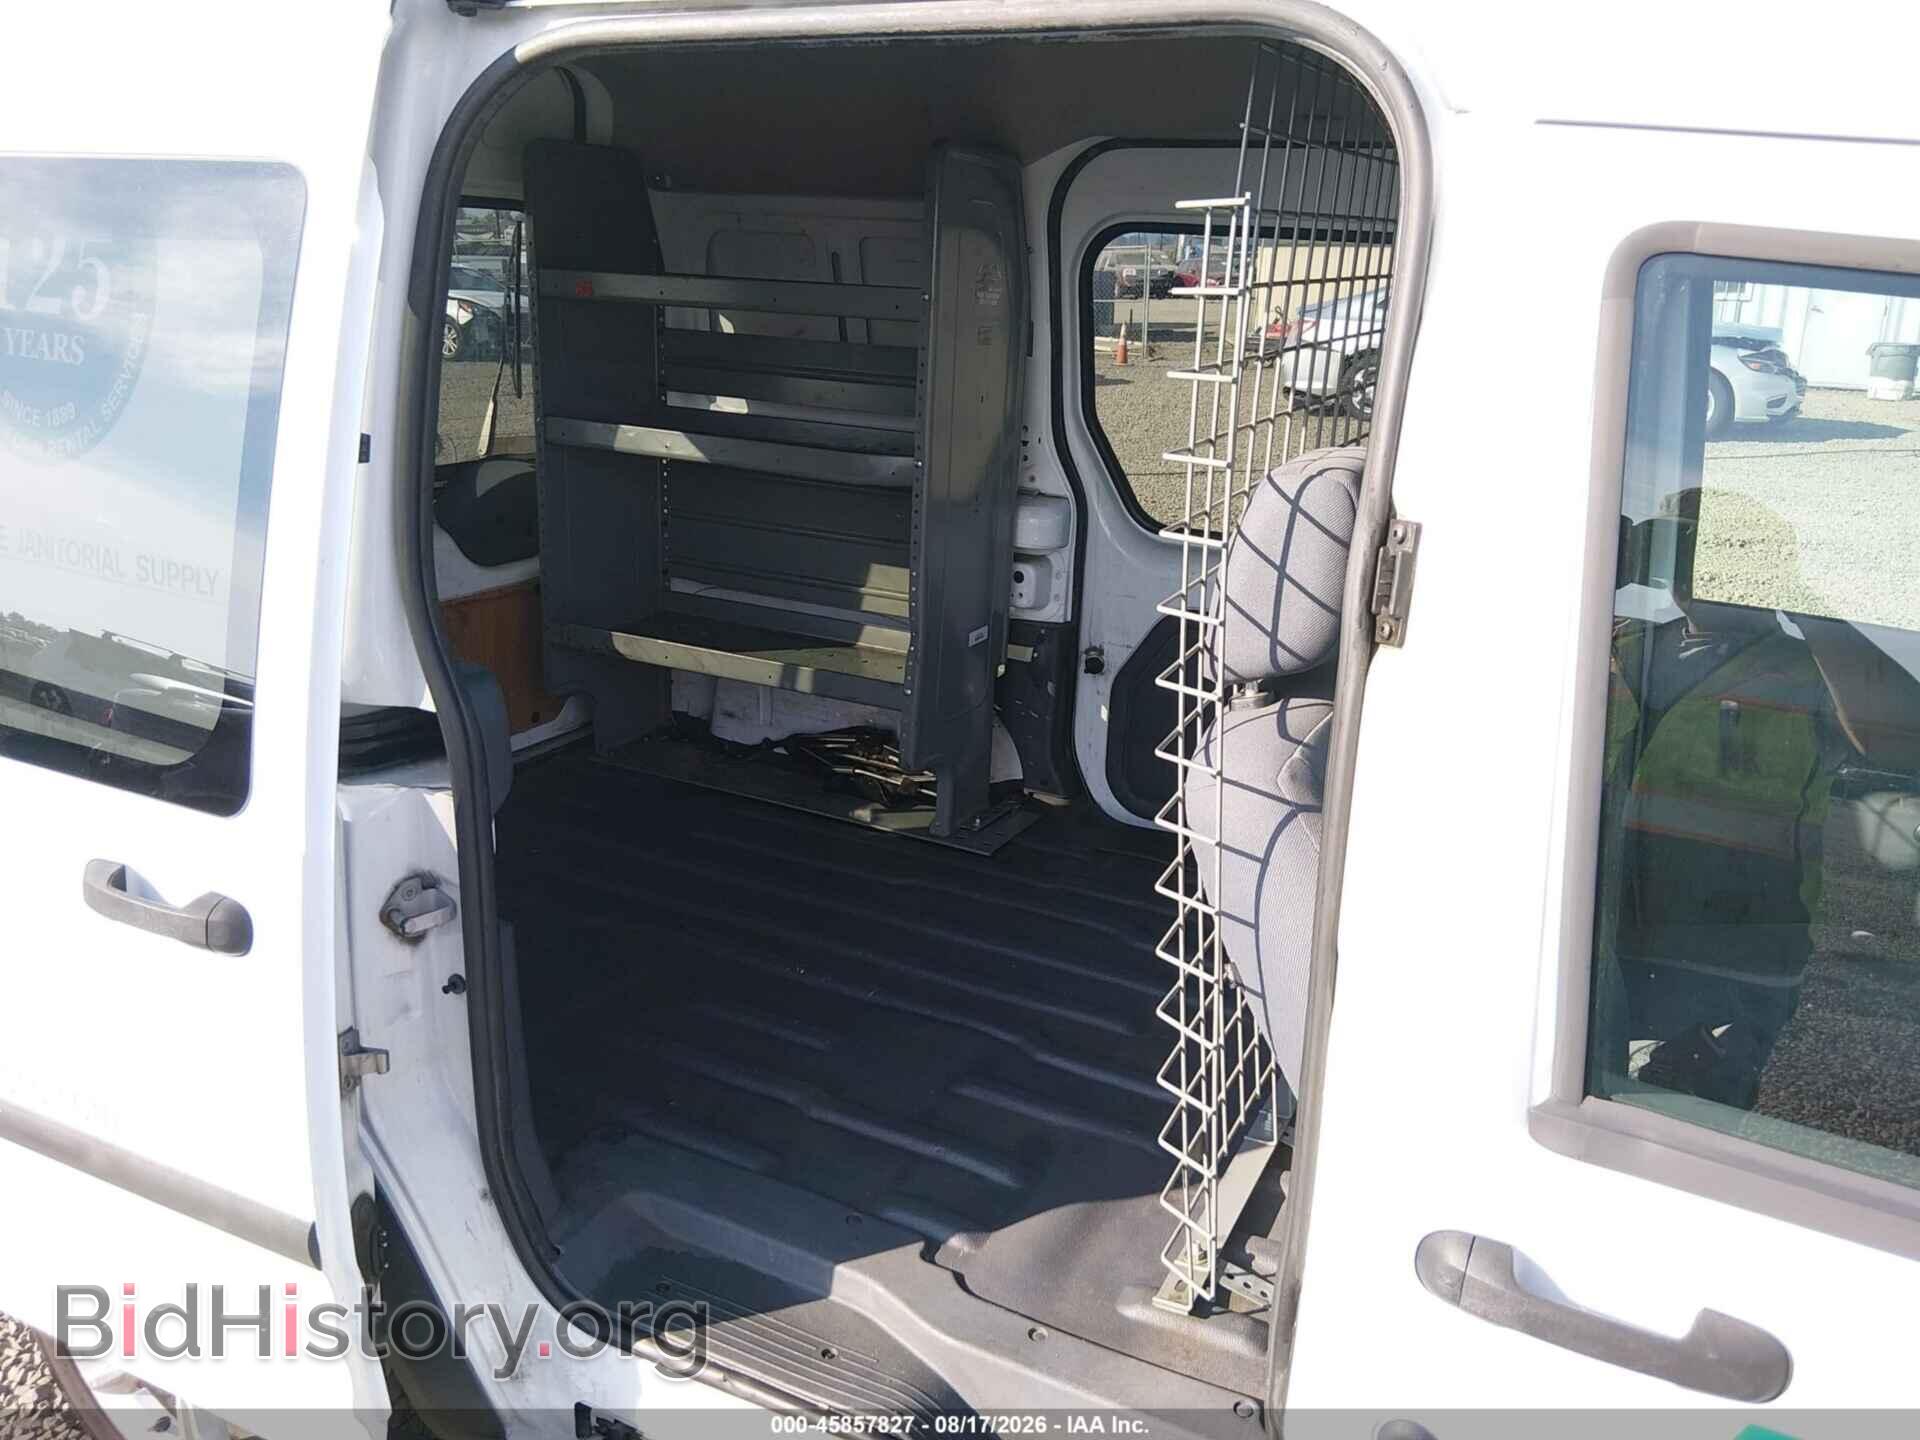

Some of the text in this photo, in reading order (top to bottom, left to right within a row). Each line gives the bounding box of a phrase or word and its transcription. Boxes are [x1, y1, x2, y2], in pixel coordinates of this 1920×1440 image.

[3, 327, 86, 367] YEARS
[17, 527, 128, 578] JANITORIAL
[135, 552, 219, 597] SUPPLY
